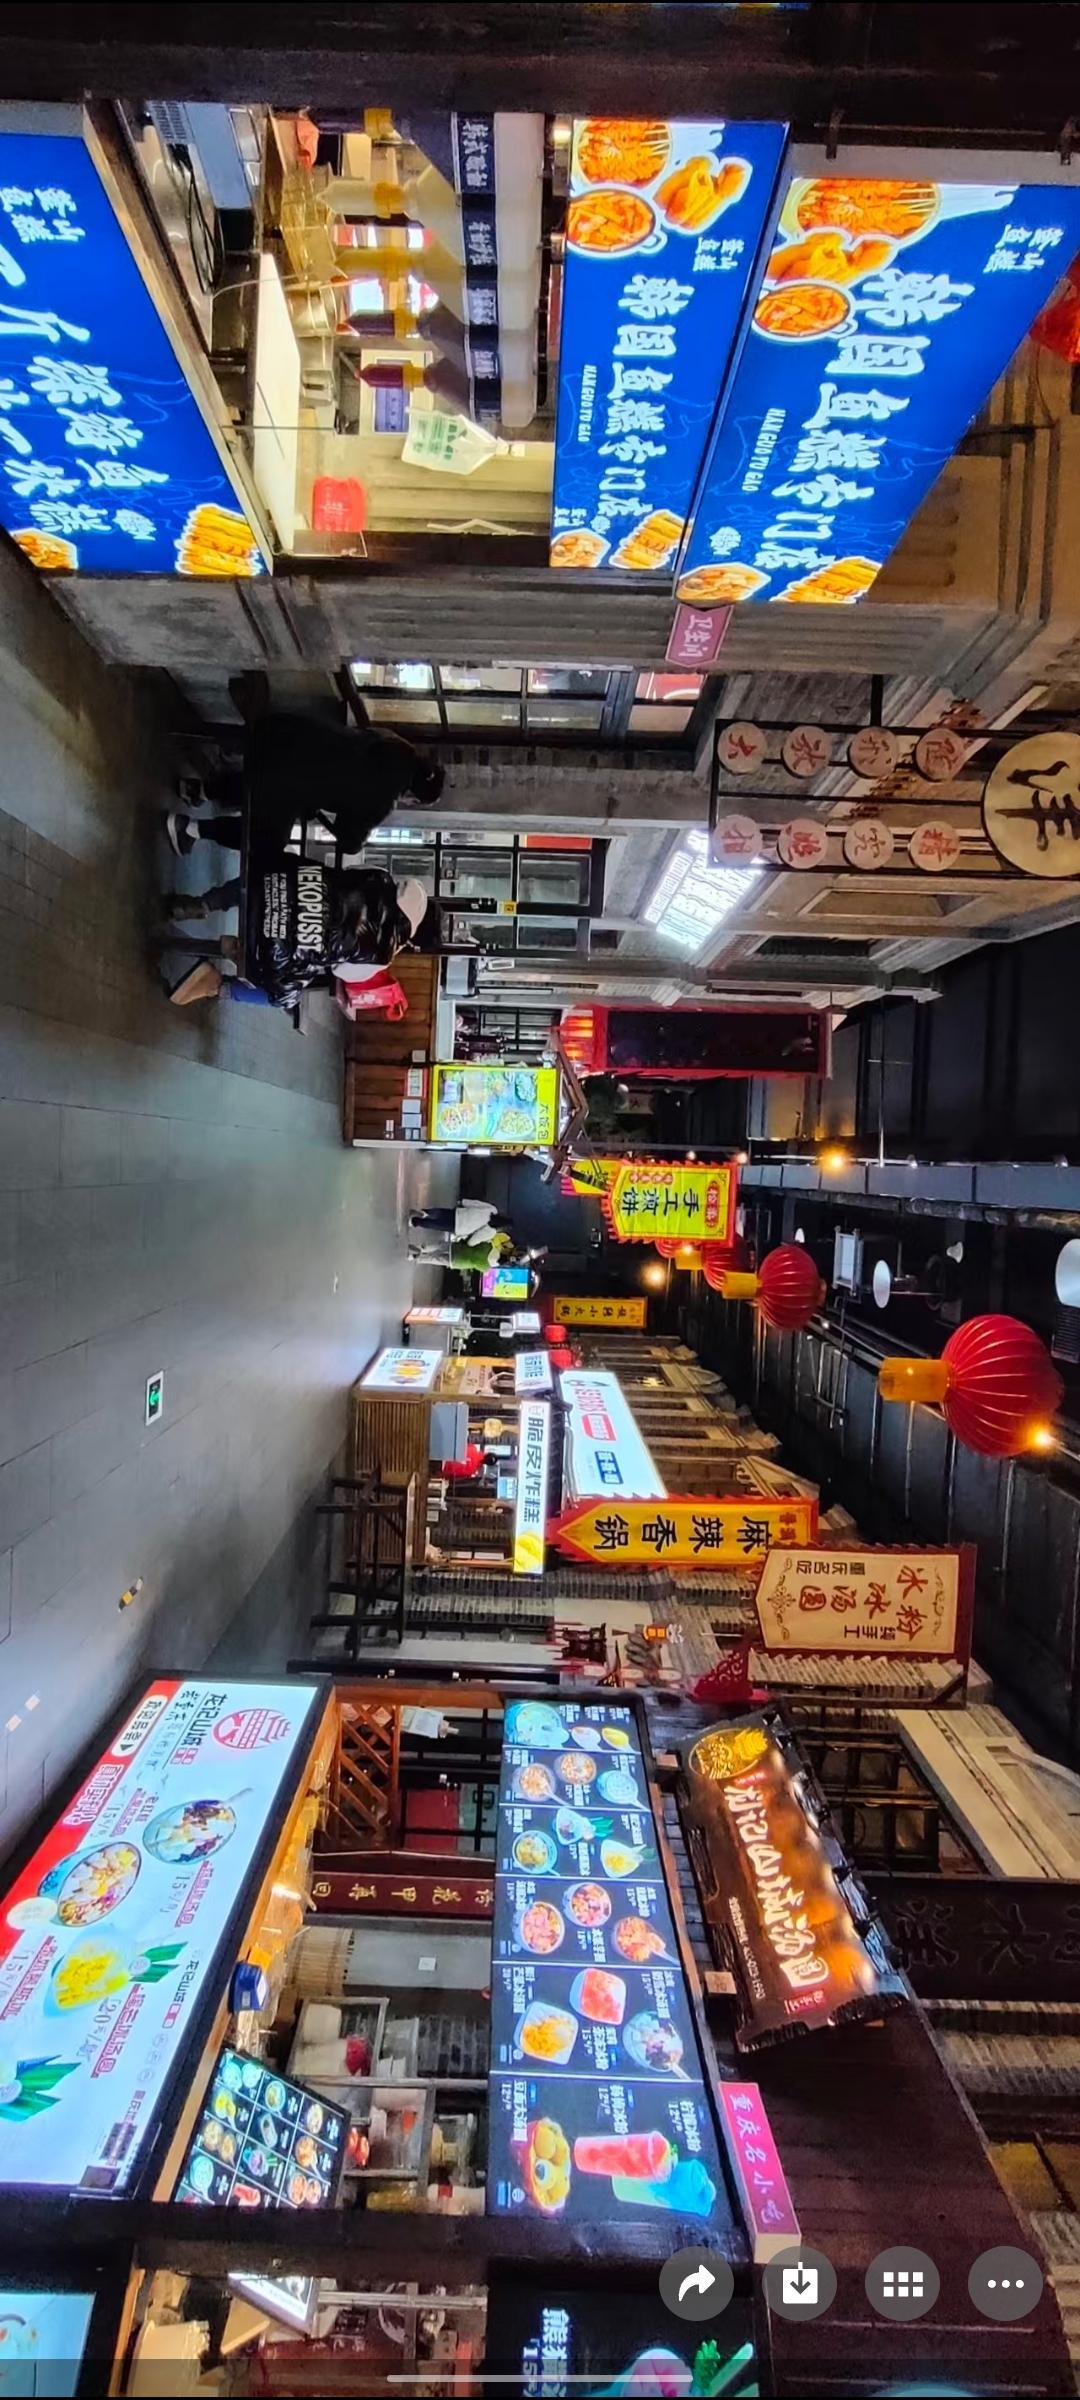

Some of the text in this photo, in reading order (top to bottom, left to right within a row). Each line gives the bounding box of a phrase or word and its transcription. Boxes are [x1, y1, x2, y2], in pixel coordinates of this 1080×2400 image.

[577, 364, 597, 443] HAN GUO YU GAO
[596, 274, 693, 517] 韩国鱼糕专门店
[754, 268, 975, 571] 韩国鱼糕专门店
[741, 408, 787, 492] HAN GUO YU GAO
[678, 614, 716, 658] 卫生间
[622, 1187, 700, 1218] 手工煎饼
[523, 1416, 544, 1524] 脆皮炸糕
[593, 1513, 773, 1554] 麻辣香锅
[795, 1560, 866, 1577] 重庆名吃
[798, 1582, 891, 1620] 冰汤圆
[843, 1624, 896, 1641] 纯手工
[896, 1565, 929, 1642] 冰粉
[729, 2093, 784, 2224] 重庆名小吃
